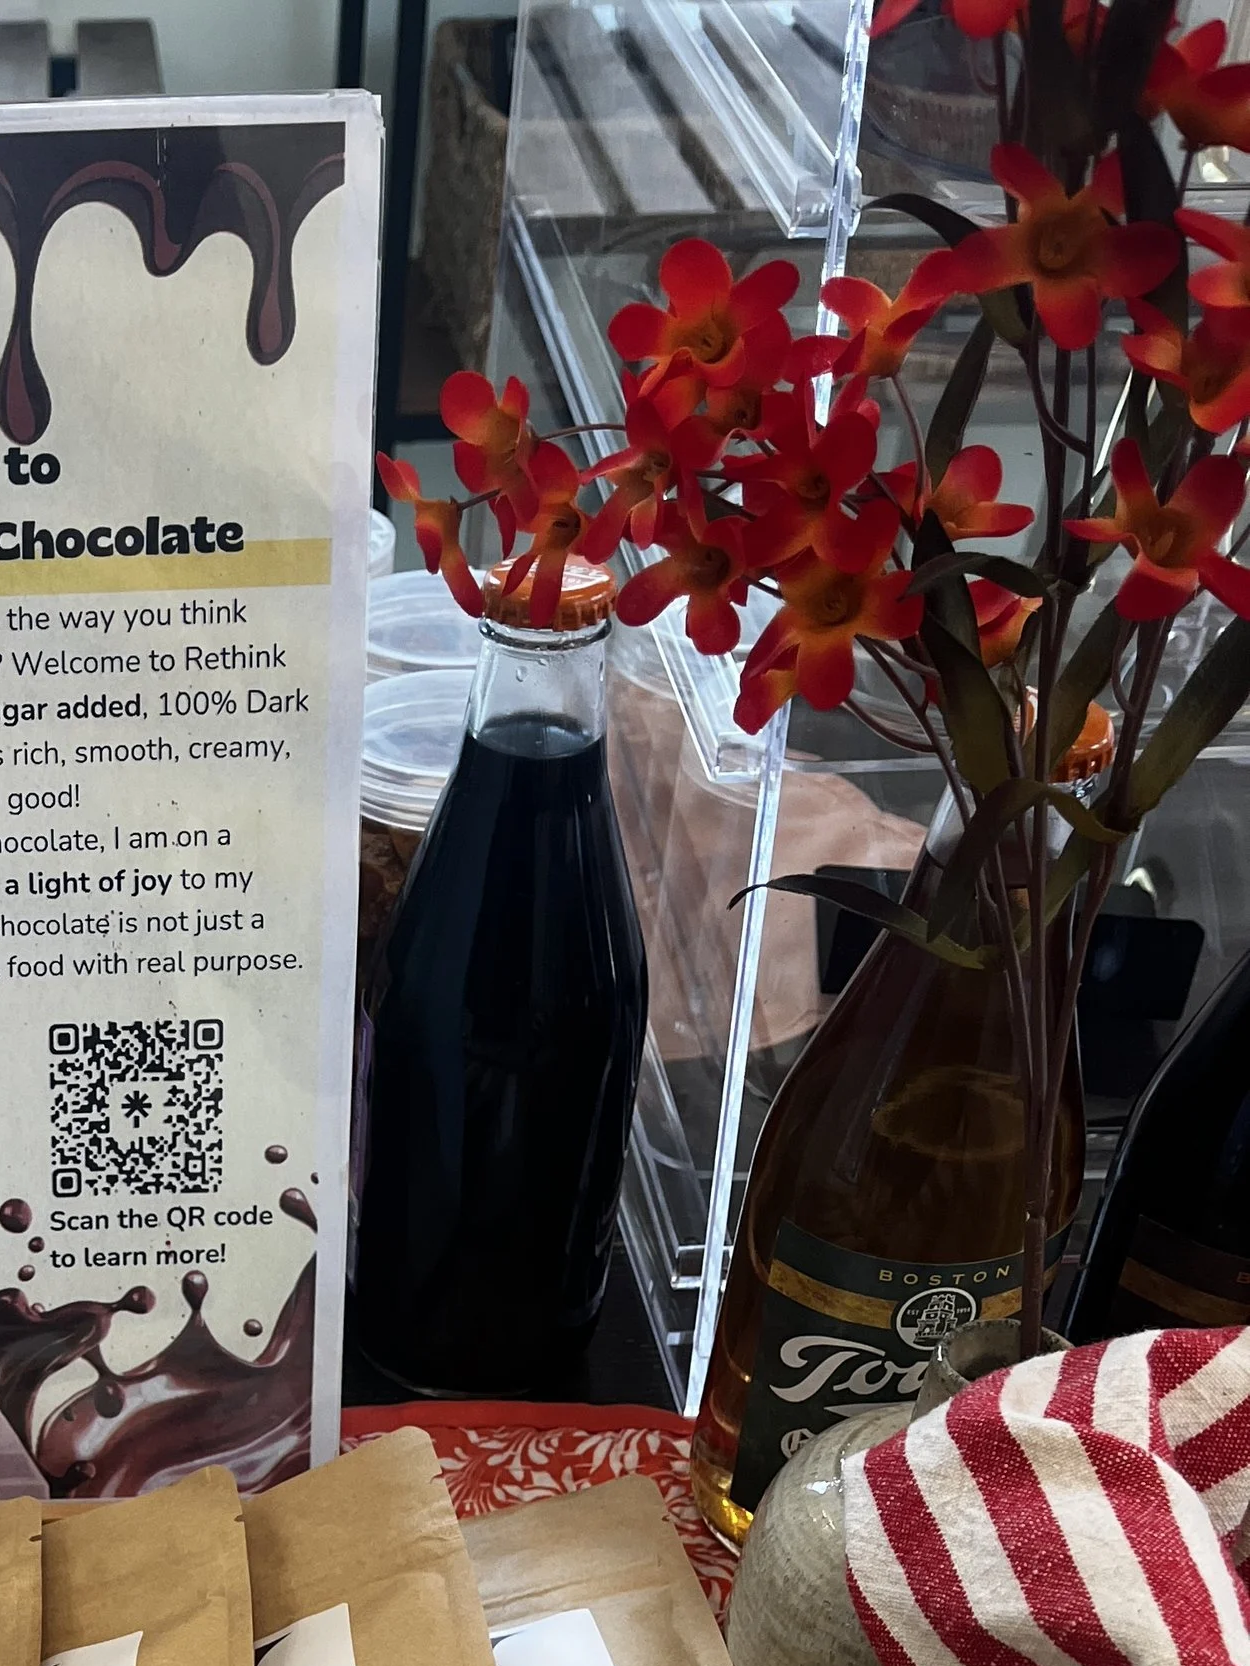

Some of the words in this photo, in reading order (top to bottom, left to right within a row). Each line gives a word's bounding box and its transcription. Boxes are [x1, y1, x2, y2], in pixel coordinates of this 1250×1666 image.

[2, 447, 61, 485] to
[3, 606, 50, 632] the
[59, 610, 115, 634] way
[123, 608, 171, 633] you
[179, 598, 247, 627] think
[11, 649, 142, 678] Welcome
[146, 650, 175, 673] to
[184, 643, 286, 672] Rethink
[57, 693, 147, 721] added,
[158, 690, 237, 716] 100%
[246, 688, 309, 714] Dark
[14, 740, 65, 767] rich,
[75, 736, 179, 763] smooth,
[188, 737, 290, 762] creamy,
[7, 784, 79, 815] good!
[114, 826, 119, 850] I
[128, 831, 167, 849] am
[177, 830, 207, 847] on
[217, 829, 230, 846] a
[5, 879, 19, 896] a
[28, 871, 90, 900] light
[99, 869, 126, 893] of
[132, 867, 172, 897] joy
[177, 869, 205, 890] to
[215, 871, 253, 896] my
[118, 910, 138, 933] is
[147, 911, 189, 933] not
[192, 909, 243, 938] just
[251, 913, 264, 929] a
[6, 954, 63, 978] food
[73, 951, 128, 976] with
[135, 950, 186, 974] real
[193, 948, 303, 977] purpose.
[50, 1211, 109, 1231] Scan
[116, 1208, 158, 1229] the
[166, 1205, 205, 1232] QR
[213, 1205, 273, 1226] code
[48, 1250, 76, 1268] to
[84, 1247, 147, 1267] learn
[156, 1243, 226, 1265] more!
[879, 1265, 1012, 1286] BOSTON
